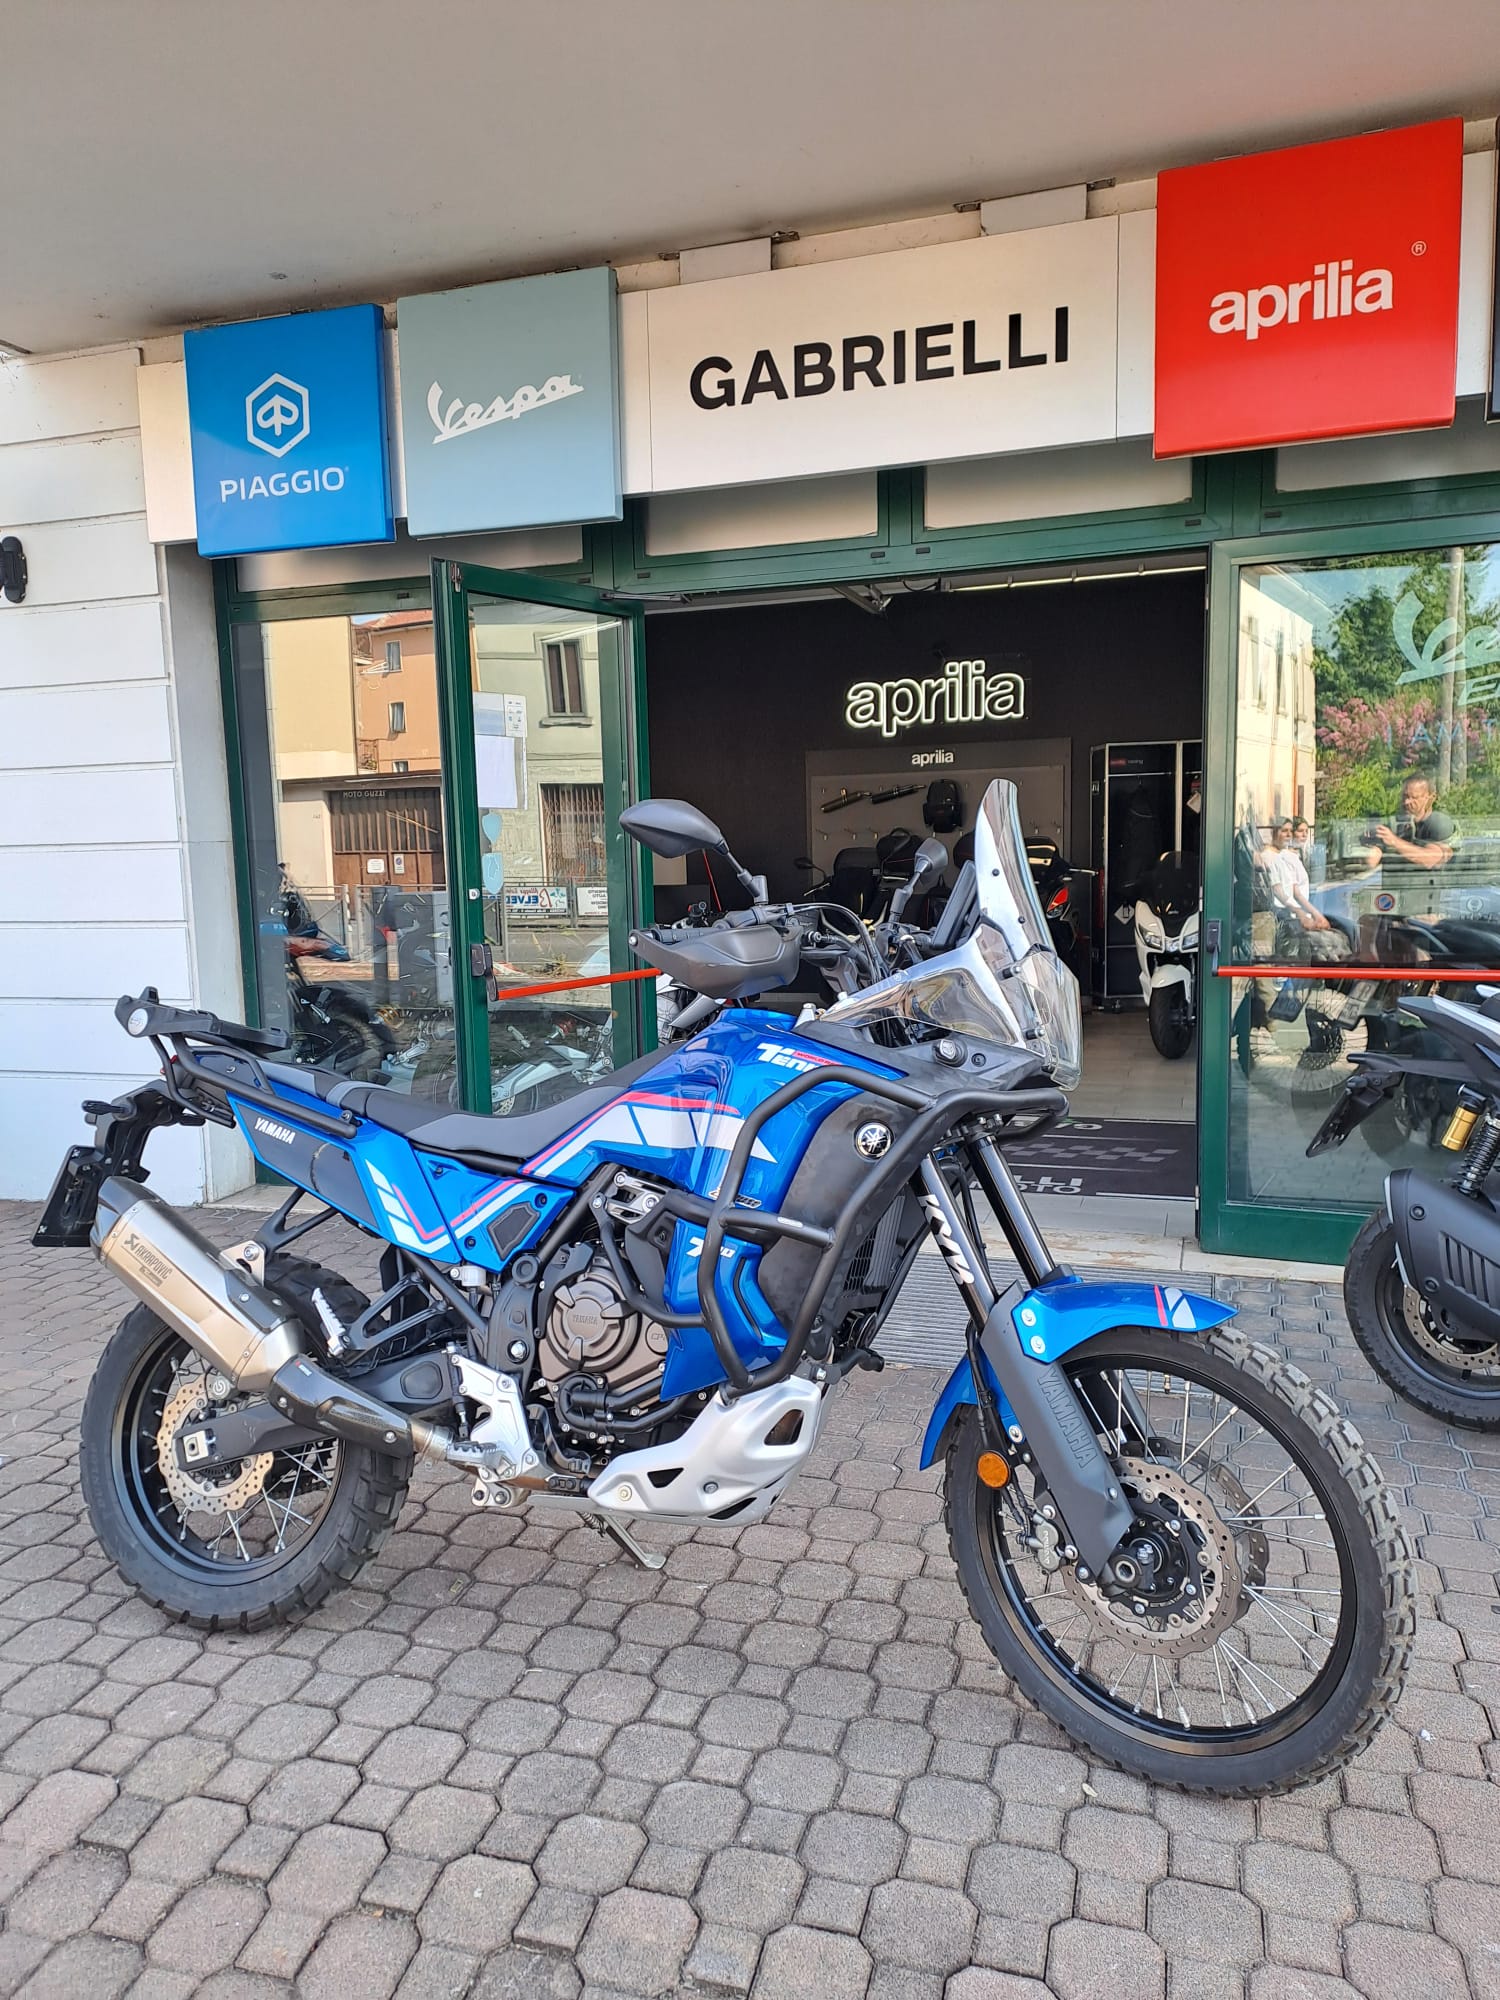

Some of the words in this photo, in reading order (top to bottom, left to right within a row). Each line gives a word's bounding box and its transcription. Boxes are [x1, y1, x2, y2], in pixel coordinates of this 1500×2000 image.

[1209, 259, 1393, 340] aprilia
[690, 306, 1070, 411] GABRIELLI
[427, 373, 584, 444] Vespa
[219, 467, 346, 503] PIAGGIO
[845, 659, 1026, 737] aprilia
[911, 750, 954, 767] aprilia
[343, 791, 363, 799] MOTO
[364, 790, 386, 798] GUZZI
[254, 1117, 296, 1145] YAMAHA
[1036, 1367, 1099, 1469] YAMAHA
